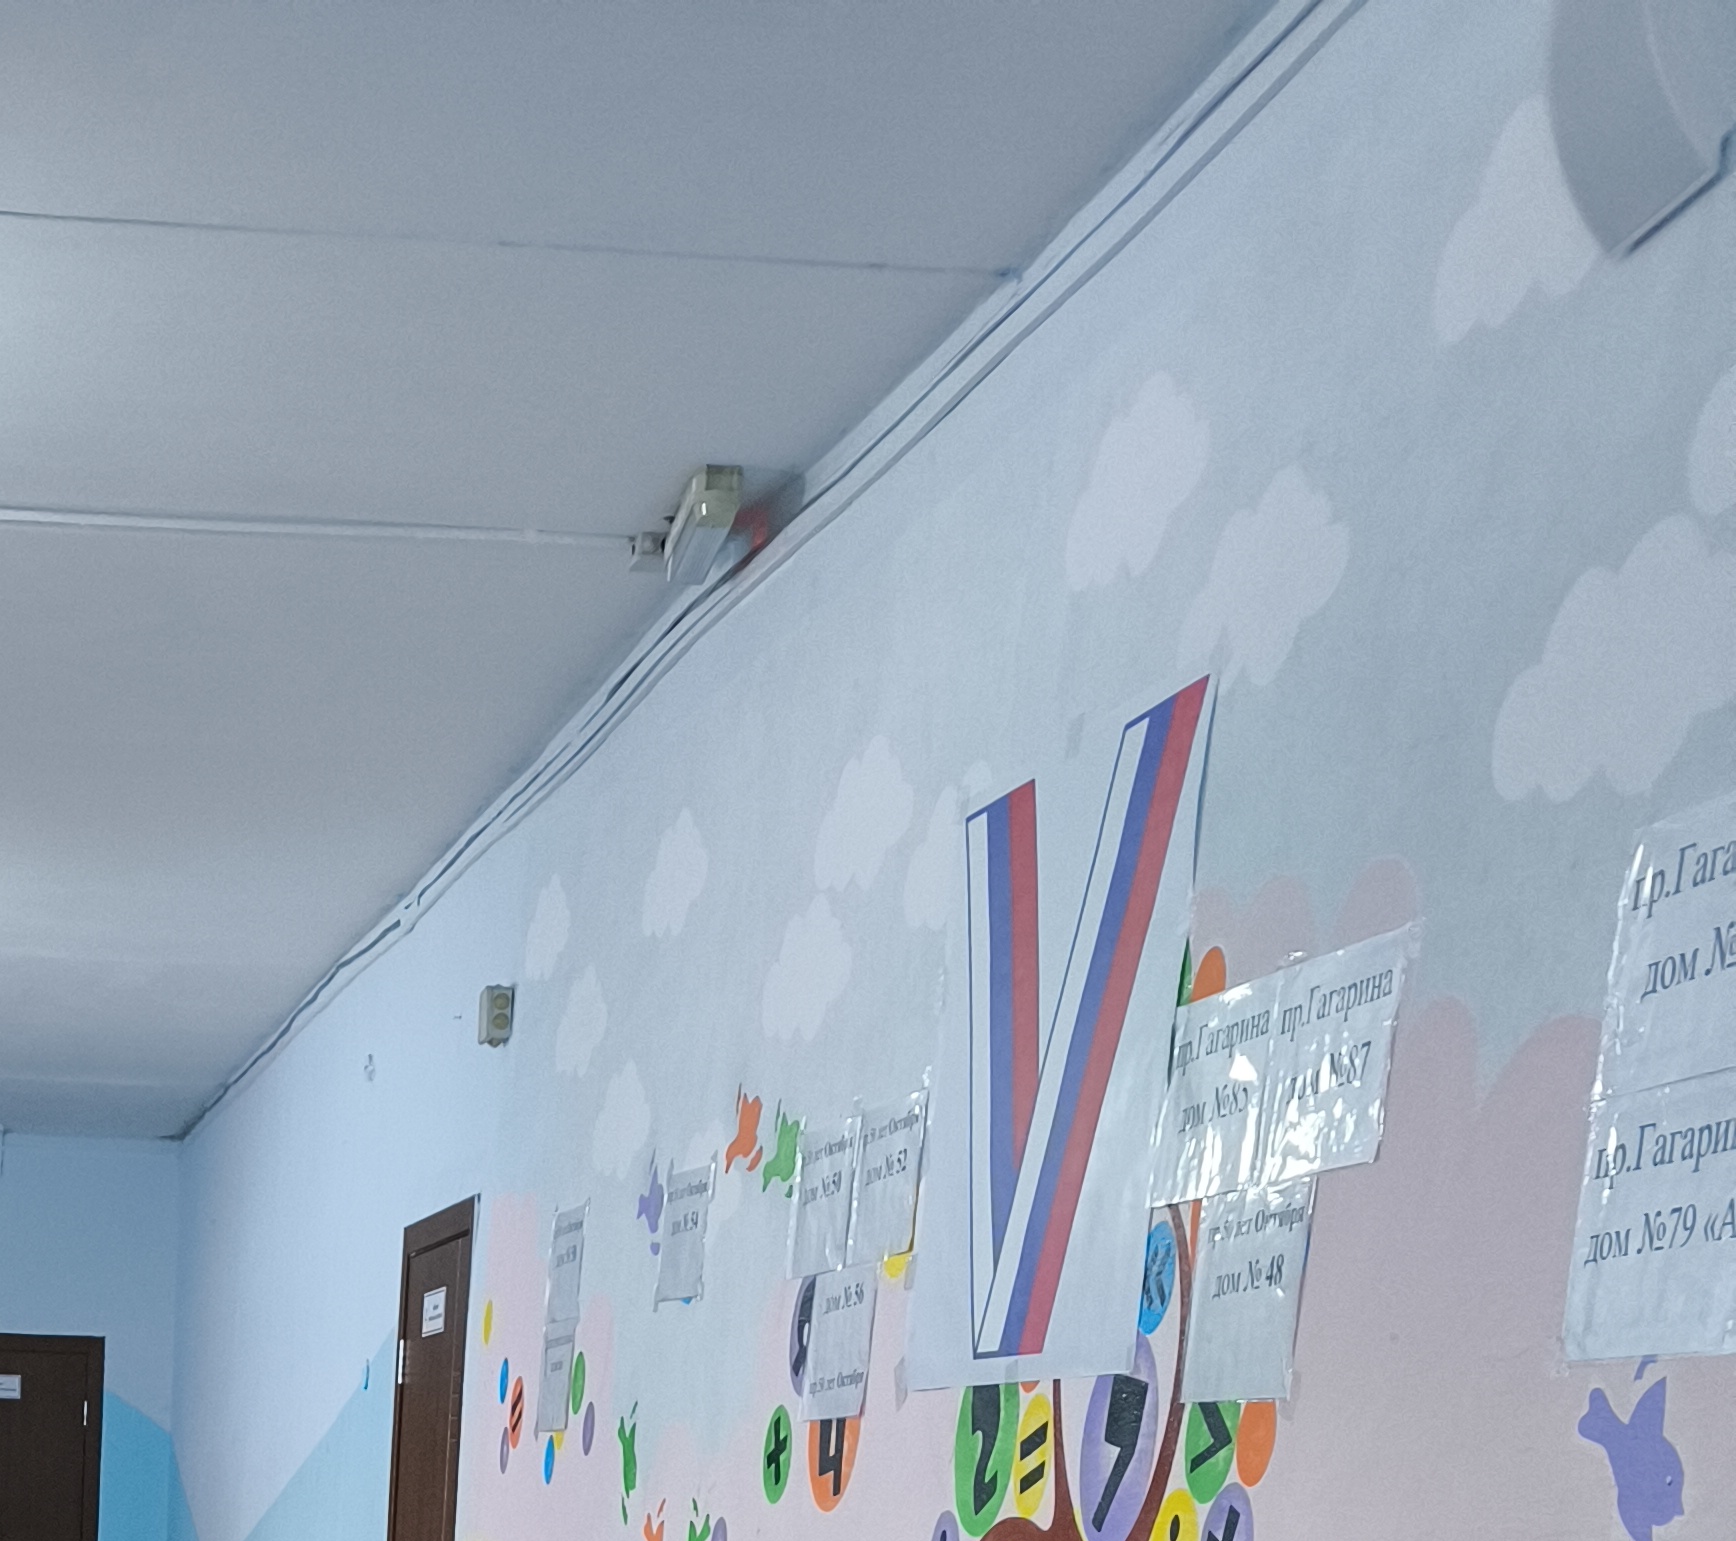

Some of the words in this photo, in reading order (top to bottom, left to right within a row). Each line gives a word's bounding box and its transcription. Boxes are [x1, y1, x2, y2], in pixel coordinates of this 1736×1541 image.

[1281, 968, 1393, 1042] пр.Гагарина
[1640, 948, 1699, 1001] дом
[1175, 1009, 1270, 1076] пр.Гагарина
[1583, 1228, 1631, 1268] дом
[1636, 1203, 1697, 1255] №79
[1265, 1254, 1284, 1286] 48
